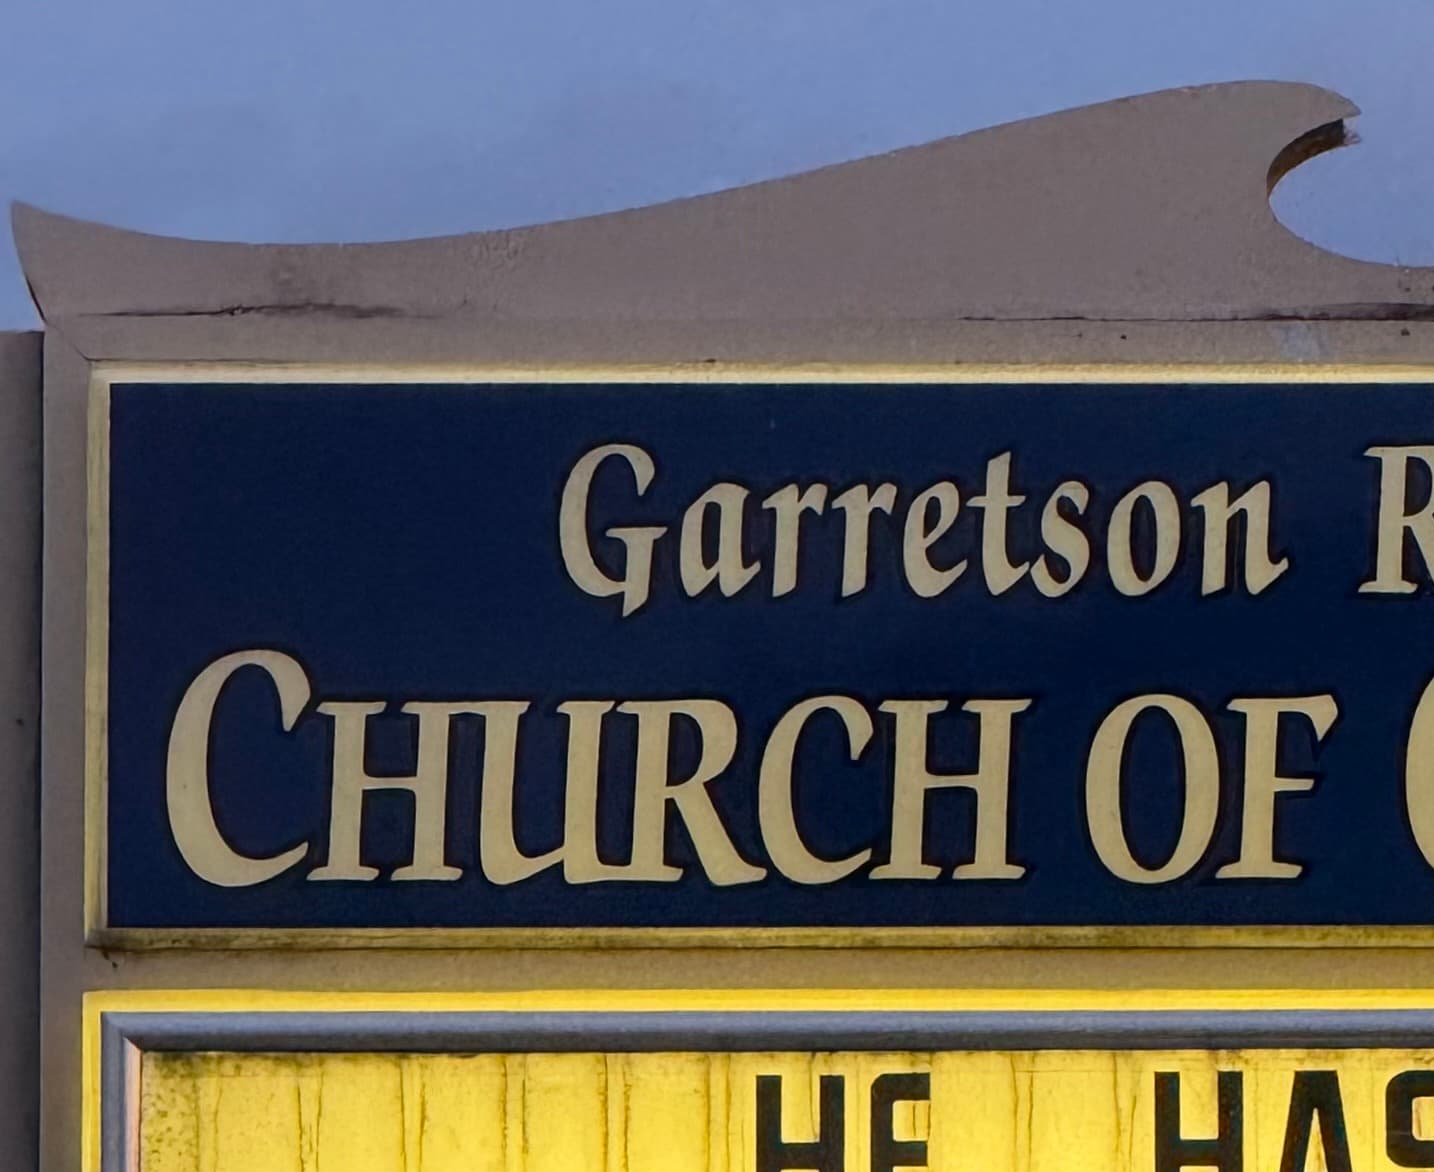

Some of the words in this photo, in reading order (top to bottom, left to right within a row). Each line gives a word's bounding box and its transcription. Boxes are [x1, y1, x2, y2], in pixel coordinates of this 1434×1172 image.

[556, 442, 1290, 618] Garretson
[166, 649, 1033, 887] CHURCH
[1084, 692, 1339, 885] OF
